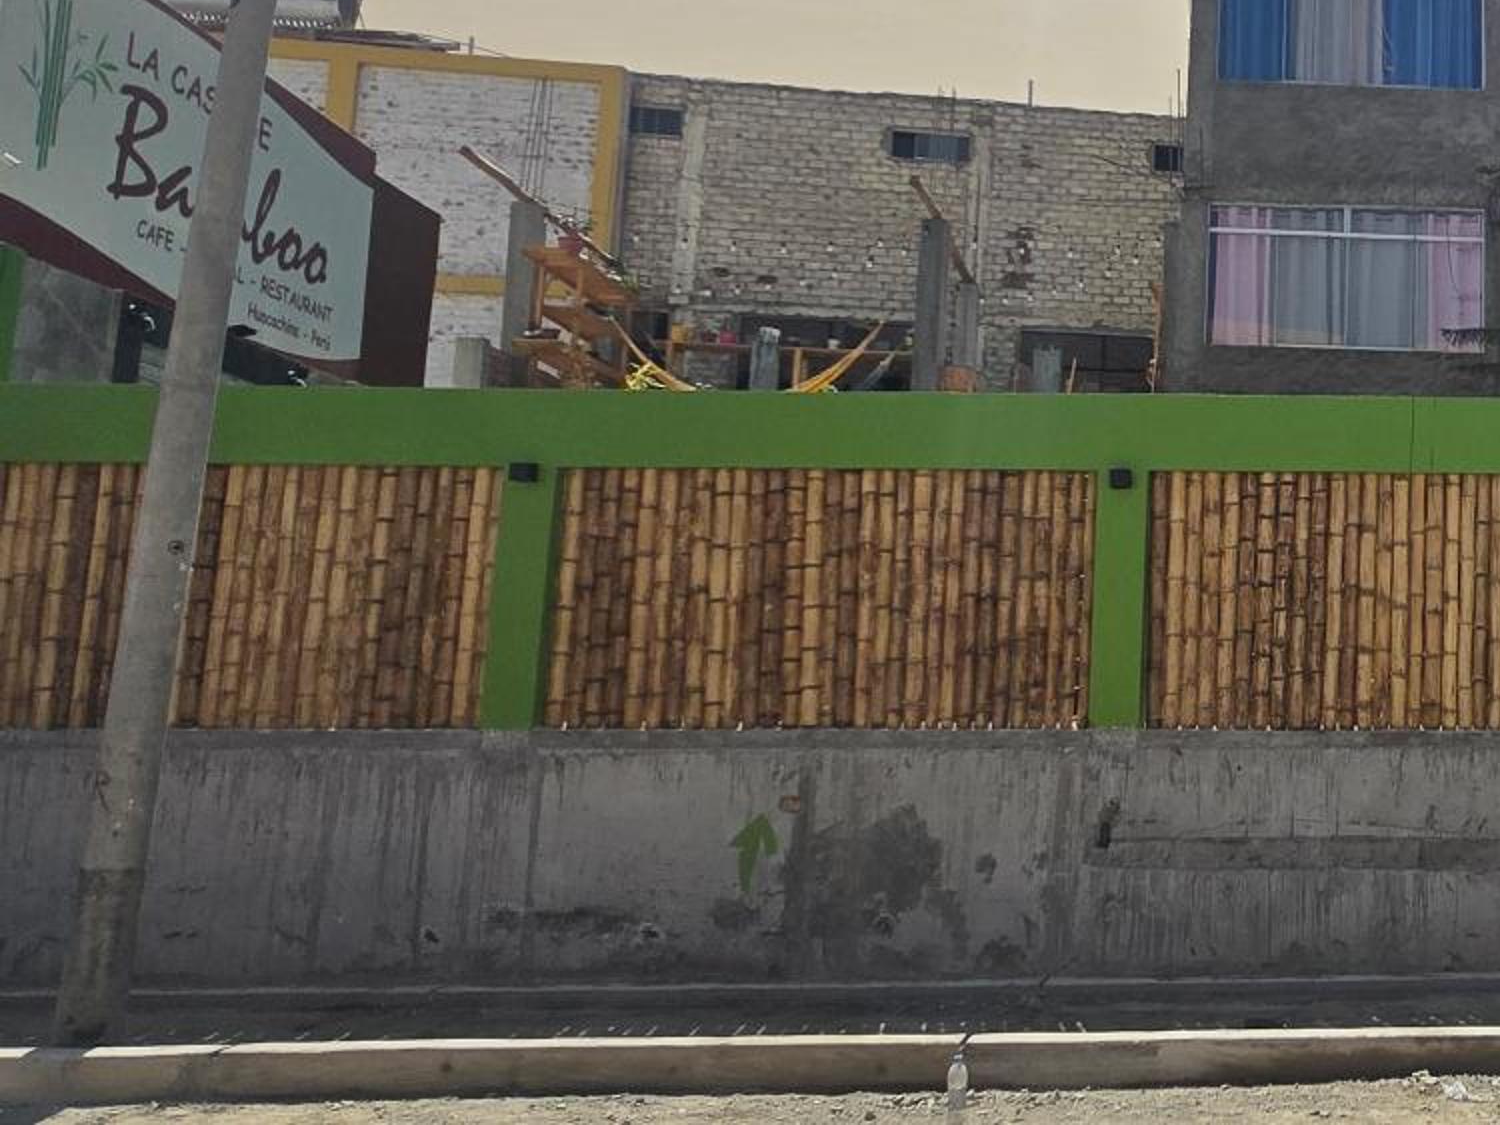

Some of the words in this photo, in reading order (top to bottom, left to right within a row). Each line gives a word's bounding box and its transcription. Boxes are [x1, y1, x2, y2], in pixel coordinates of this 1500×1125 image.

[127, 32, 160, 81] LA
[172, 64, 217, 116] CAS
[257, 116, 273, 152] E
[106, 84, 327, 285] Baboo
[136, 219, 175, 252] CAFE
[261, 275, 334, 323] RESTAURANT
